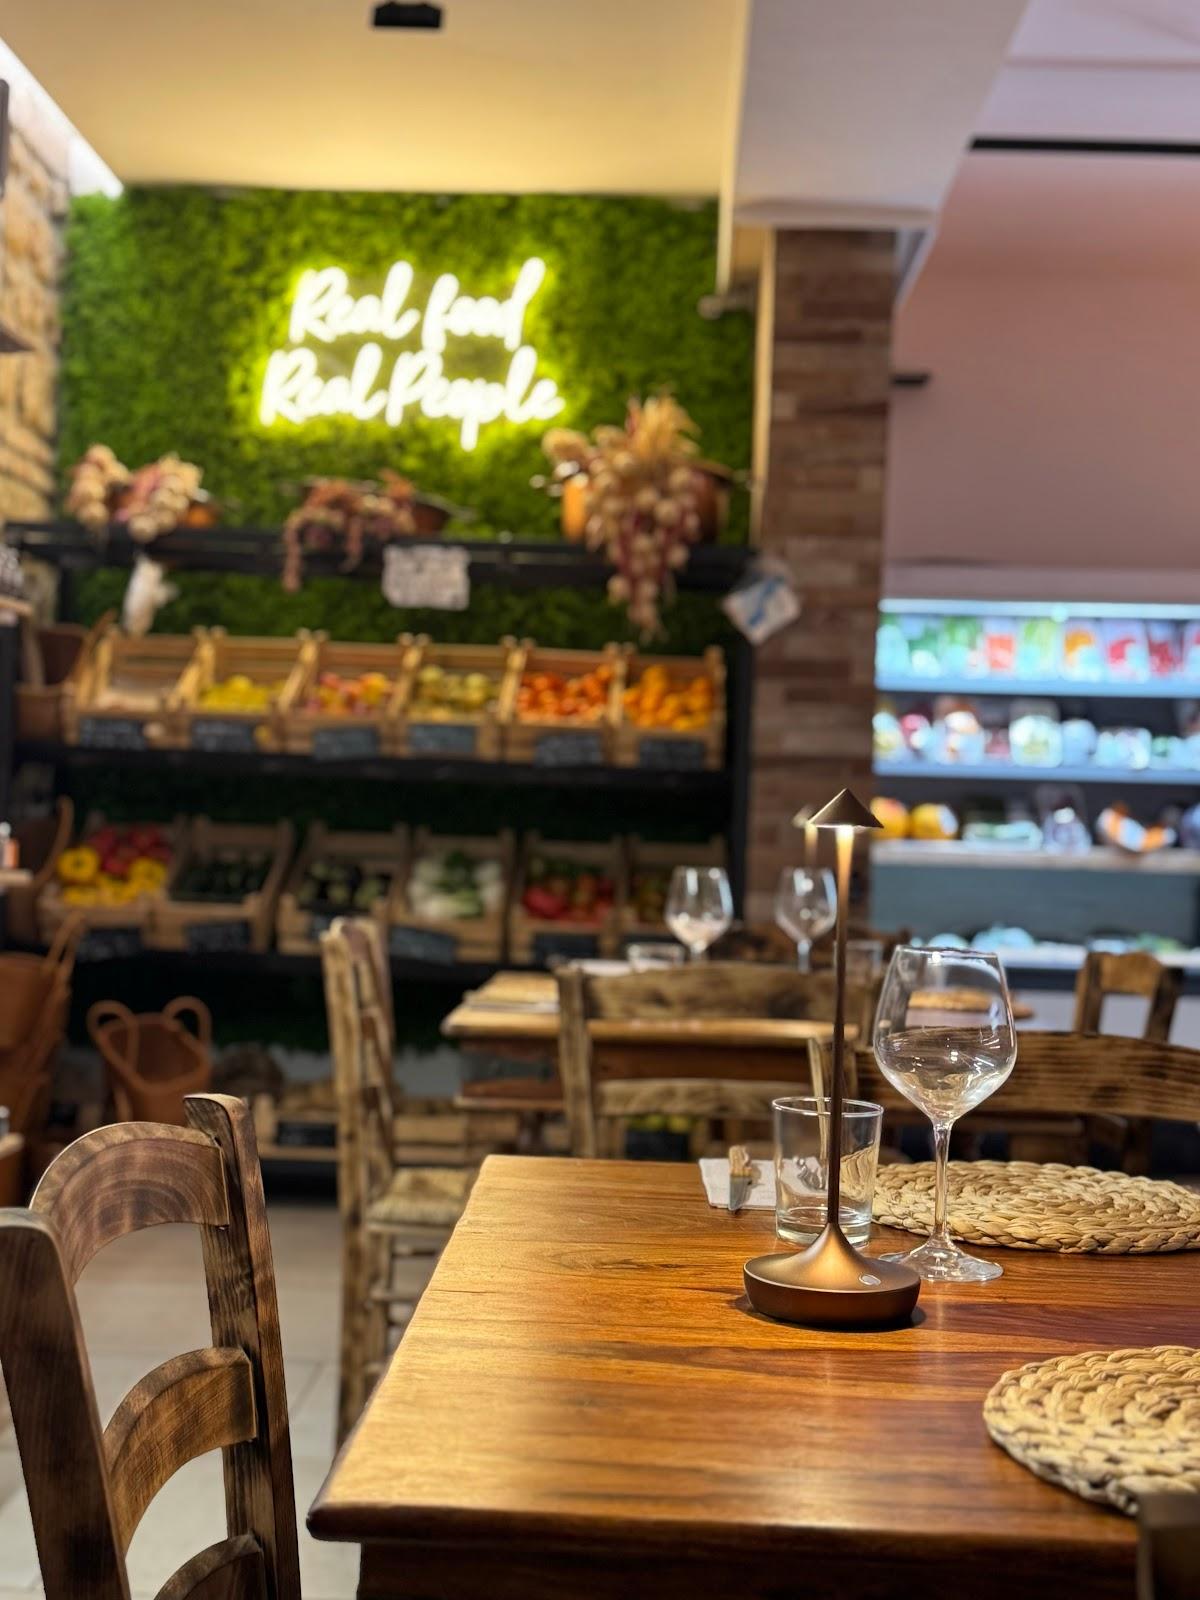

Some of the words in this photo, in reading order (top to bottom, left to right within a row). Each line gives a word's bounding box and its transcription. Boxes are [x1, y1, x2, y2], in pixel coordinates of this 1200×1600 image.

[289, 260, 420, 343] Real
[421, 257, 546, 351] food
[259, 343, 389, 427] Real
[385, 346, 566, 451] People
